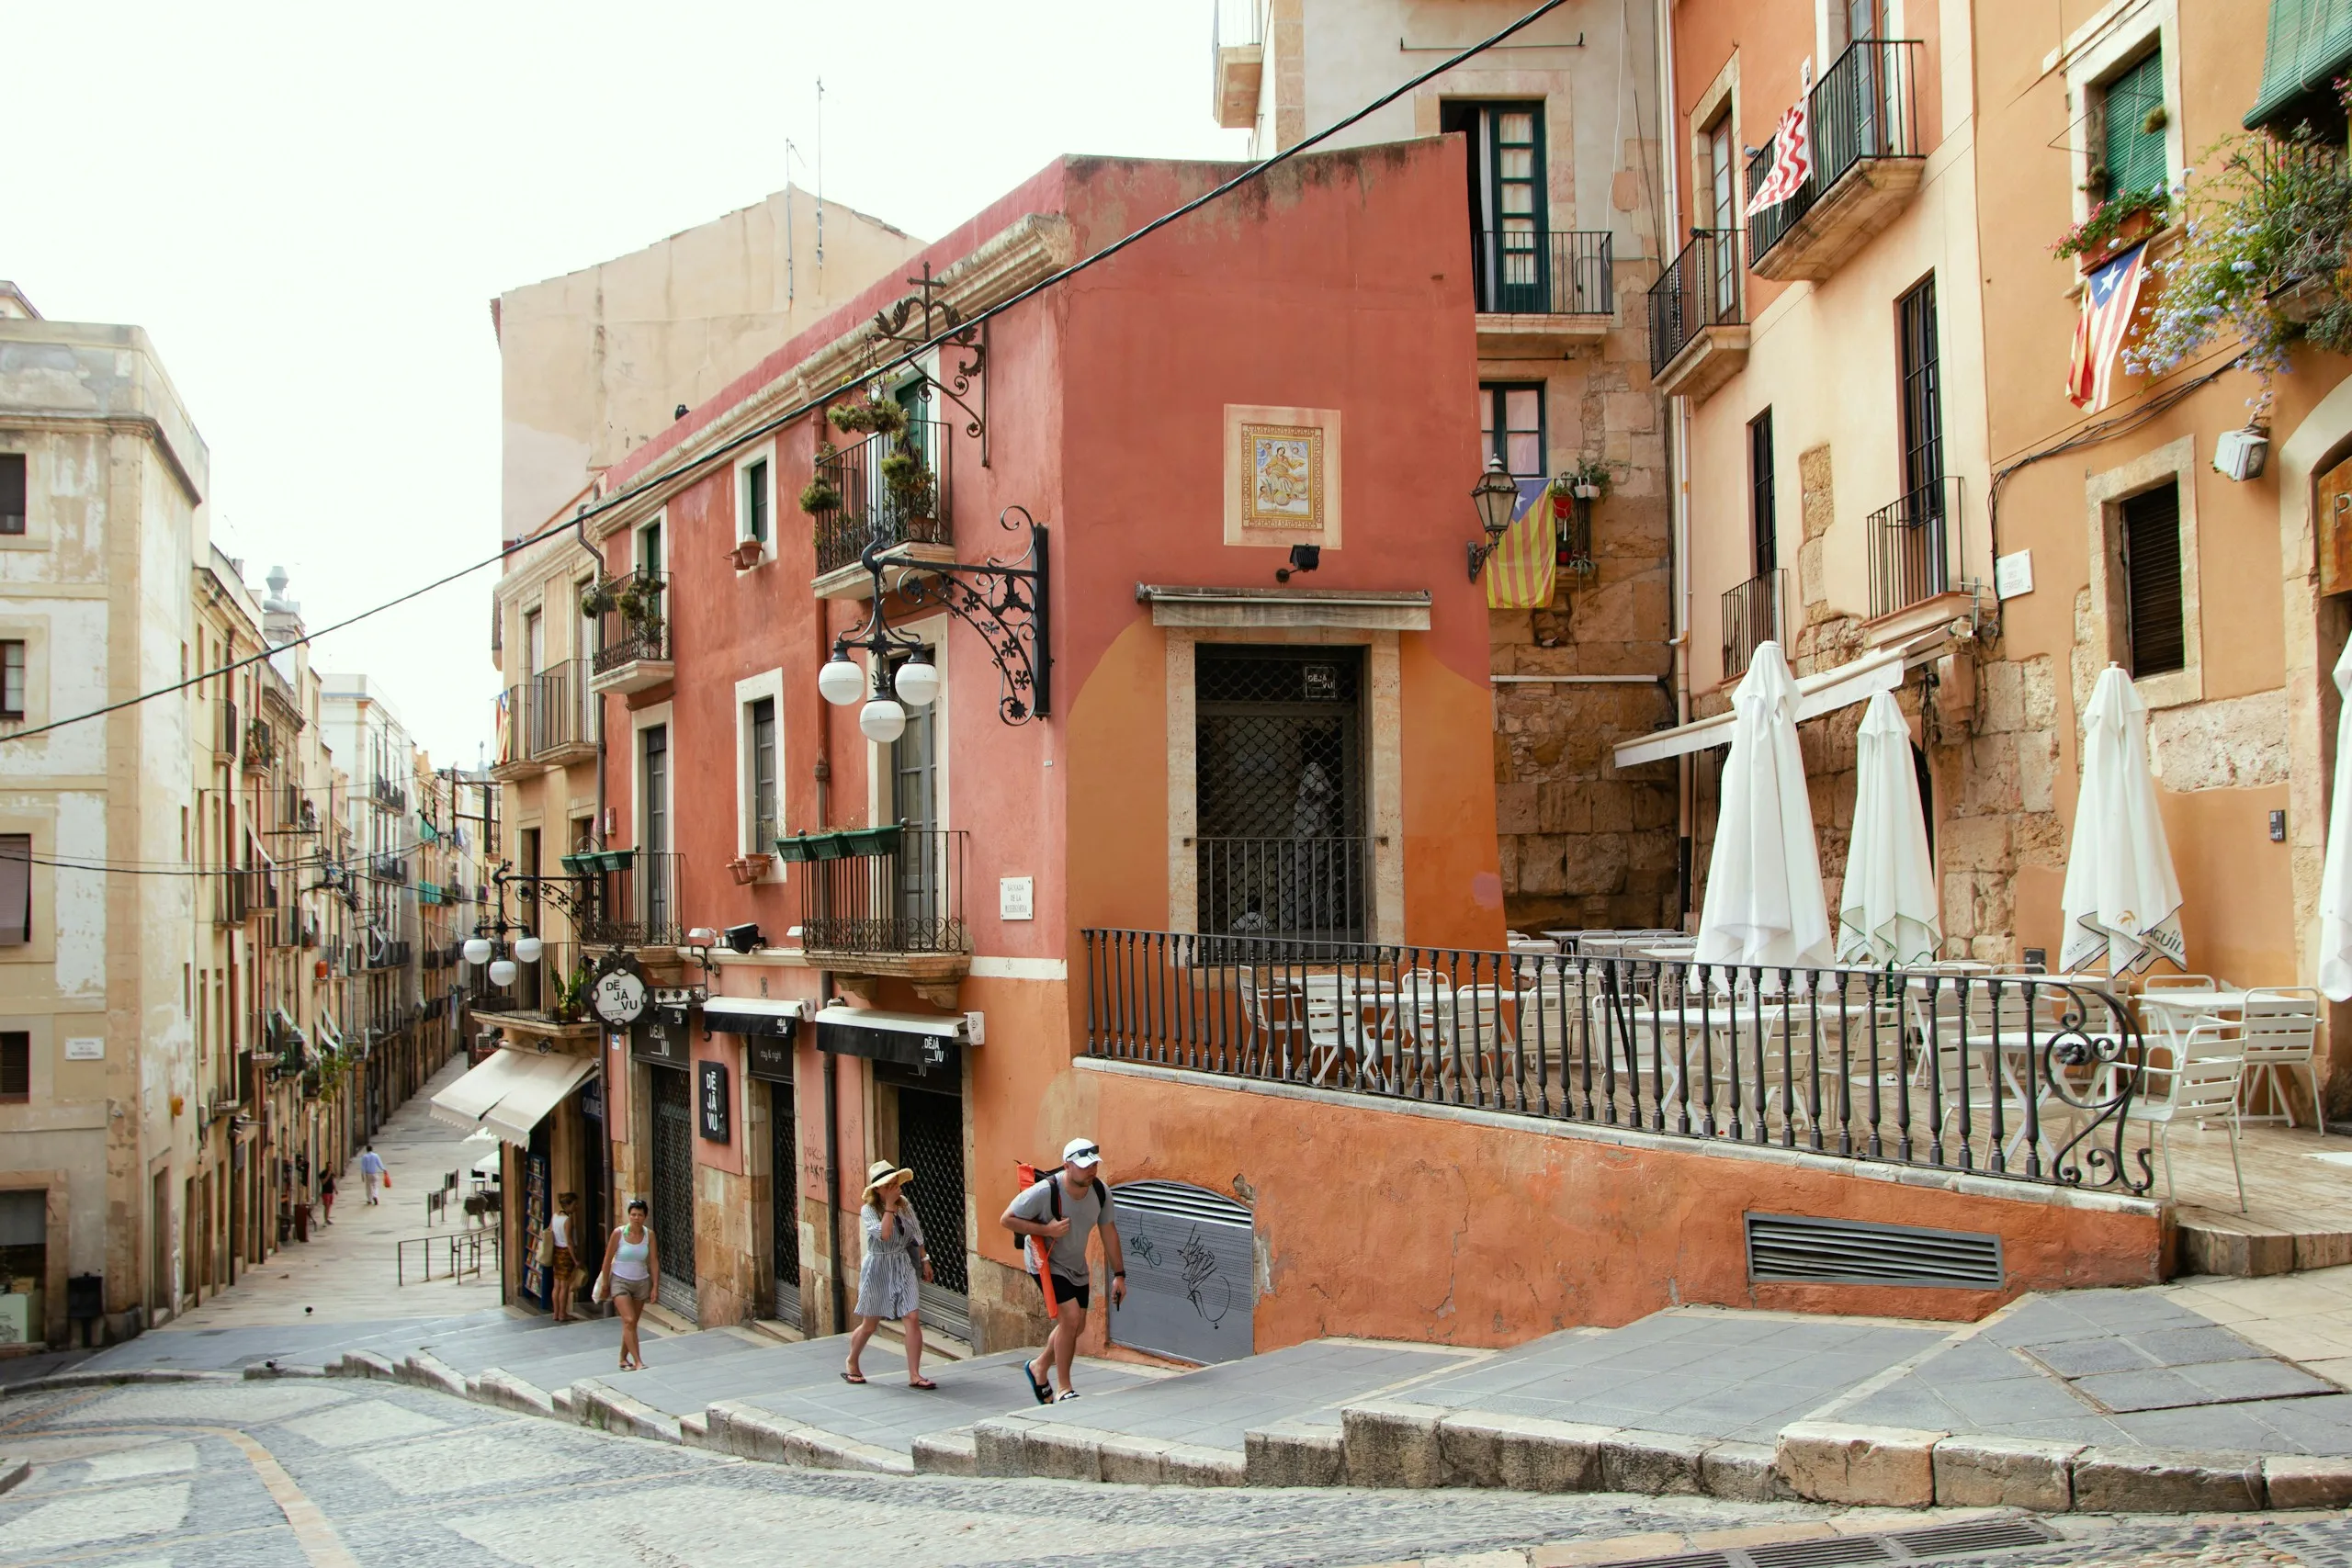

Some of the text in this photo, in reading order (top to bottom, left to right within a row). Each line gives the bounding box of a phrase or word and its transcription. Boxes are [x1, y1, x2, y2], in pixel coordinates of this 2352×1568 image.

[621, 1000, 638, 1010] VU
[661, 1040, 670, 1056] VU
[934, 1050, 944, 1063] VU
[707, 1112, 718, 1132] VU
